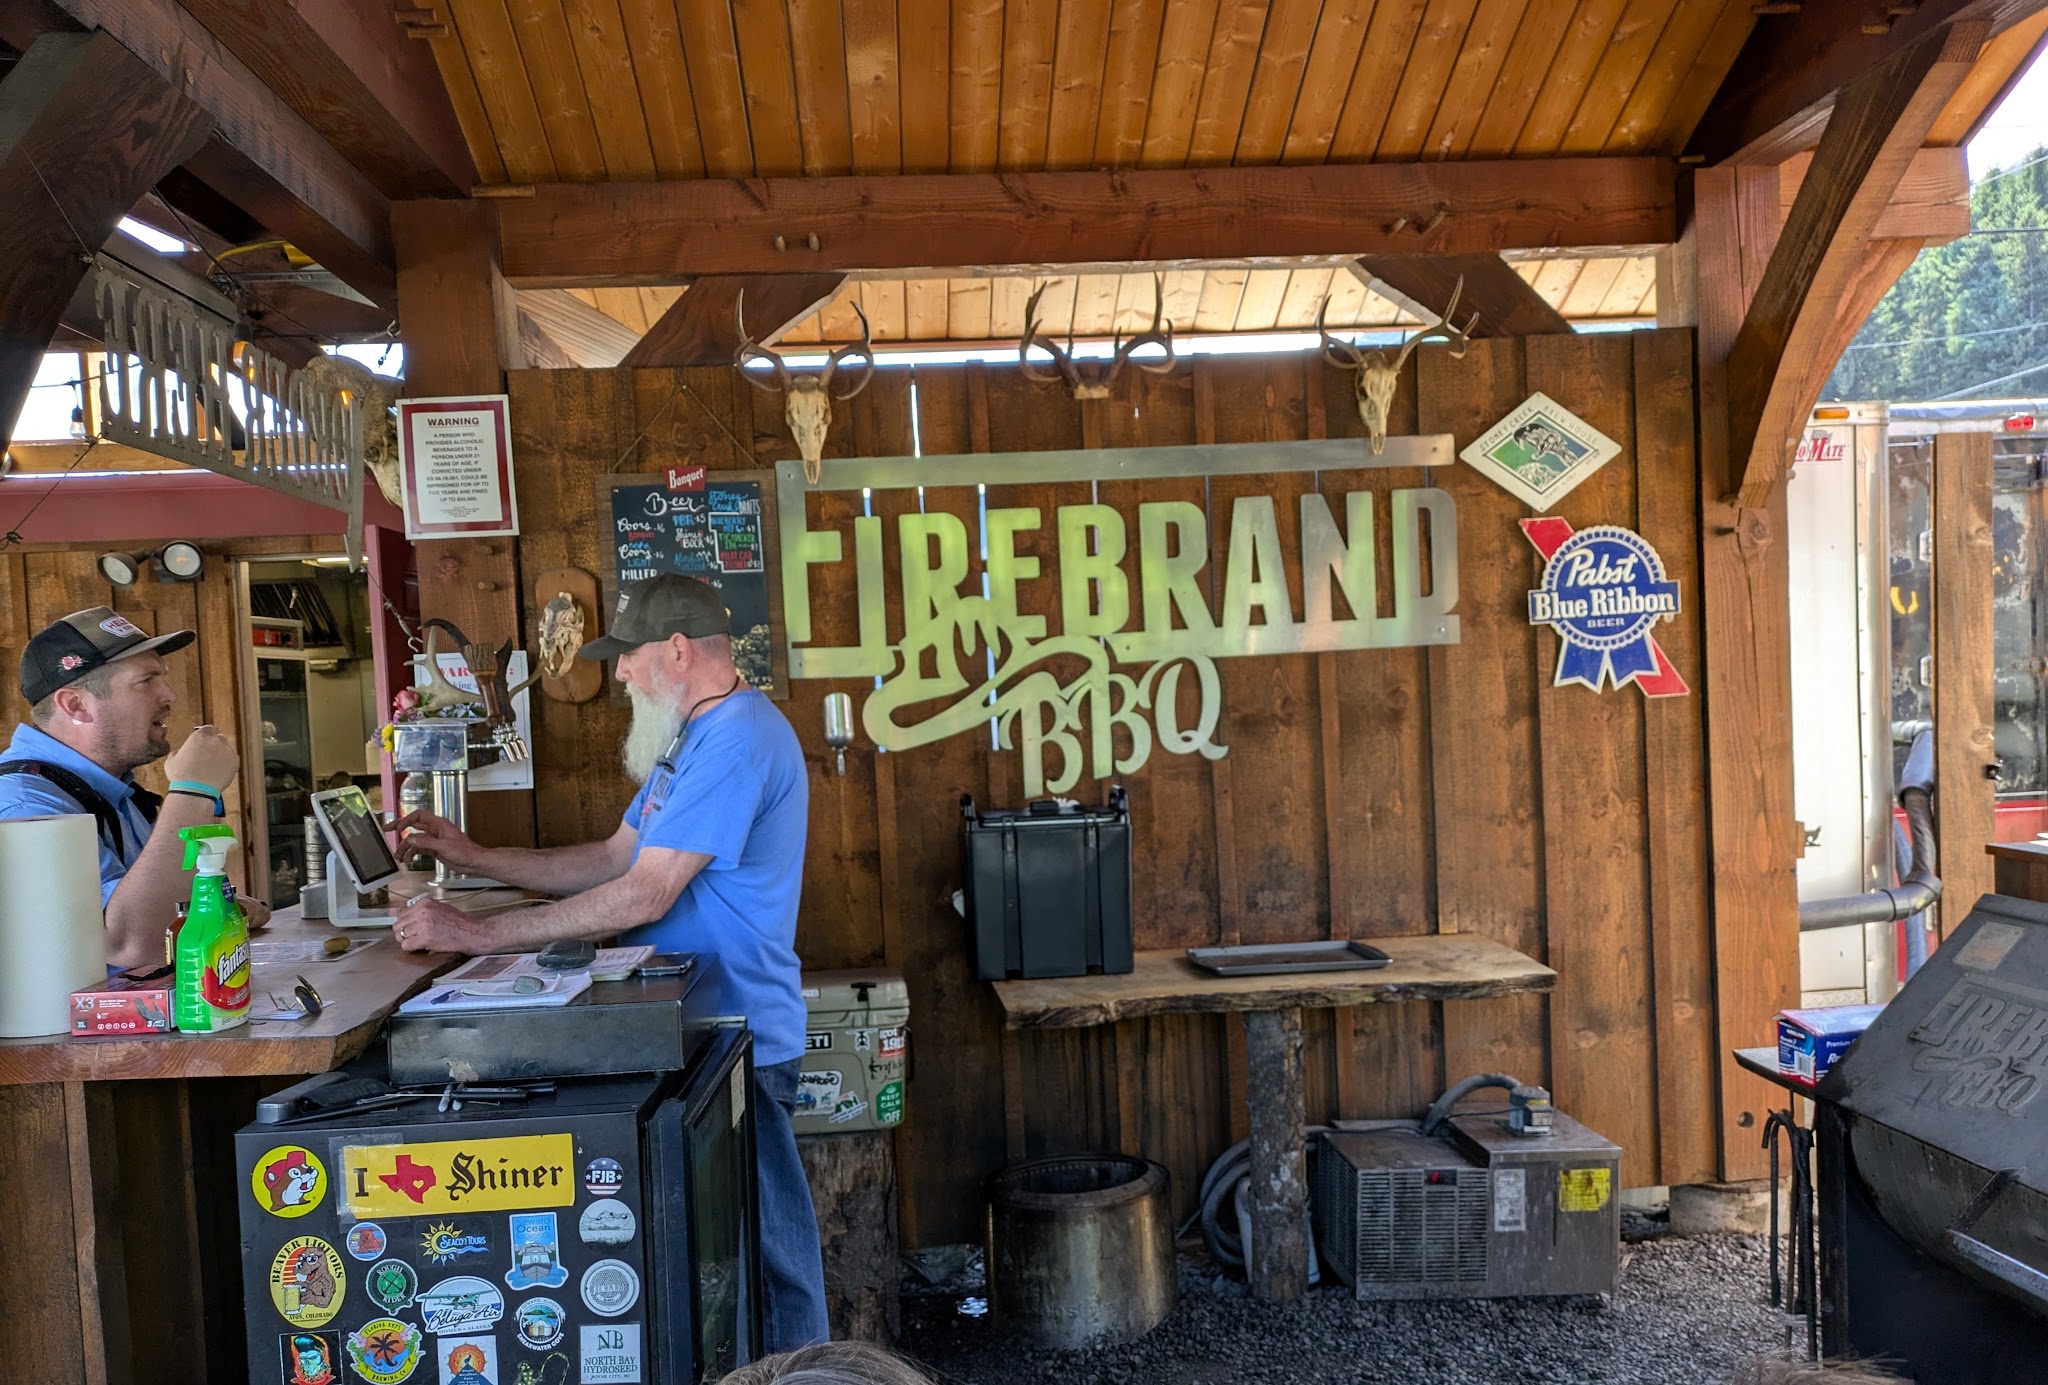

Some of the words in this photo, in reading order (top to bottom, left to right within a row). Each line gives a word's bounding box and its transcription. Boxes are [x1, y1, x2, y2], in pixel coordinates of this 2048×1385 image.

[427, 417, 479, 426] WARNING
[1543, 405, 1565, 424] BREW
[1479, 424, 1508, 451] STONEY
[1509, 406, 1534, 427] CREEK
[1807, 437, 1845, 461] MATE
[668, 467, 704, 489] Banquet
[617, 517, 652, 532] Coors
[673, 514, 694, 526] PBR
[682, 538, 705, 548] BOCK
[618, 543, 652, 560] Coors
[776, 450, 1460, 672] FIREBRAND
[1563, 548, 1639, 587] Pabst
[1533, 591, 1588, 621] Blue
[1590, 586, 1676, 616] Ribbon
[1587, 617, 1625, 628] BEER
[999, 655, 1229, 799] BBQ
[75, 997, 95, 1010] X3
[806, 1035, 829, 1048] ETI
[1826, 1040, 1851, 1048] Premium
[353, 1167, 369, 1197] I
[445, 1151, 564, 1201] Shiner
[591, 1170, 616, 1184] FJB
[516, 1225, 551, 1233] Ocean
[466, 1235, 486, 1245] TOURS
[272, 1240, 301, 1283] BEAVER
[305, 1237, 344, 1279] LIQUORS
[376, 1264, 404, 1276] ROUGH
[383, 1293, 407, 1304] RIDER
[427, 1308, 474, 1331] Beluga
[474, 1304, 501, 1318] Air
[364, 1322, 386, 1335] FLORIDA
[517, 1333, 552, 1351] SHEARWATER
[551, 1332, 565, 1347] COVE
[597, 1329, 624, 1351] NB
[584, 1355, 616, 1366] NORTH
[618, 1355, 636, 1365] BAY
[583, 1364, 638, 1374] HYDROSEED
[372, 1374, 398, 1382] BREWING
